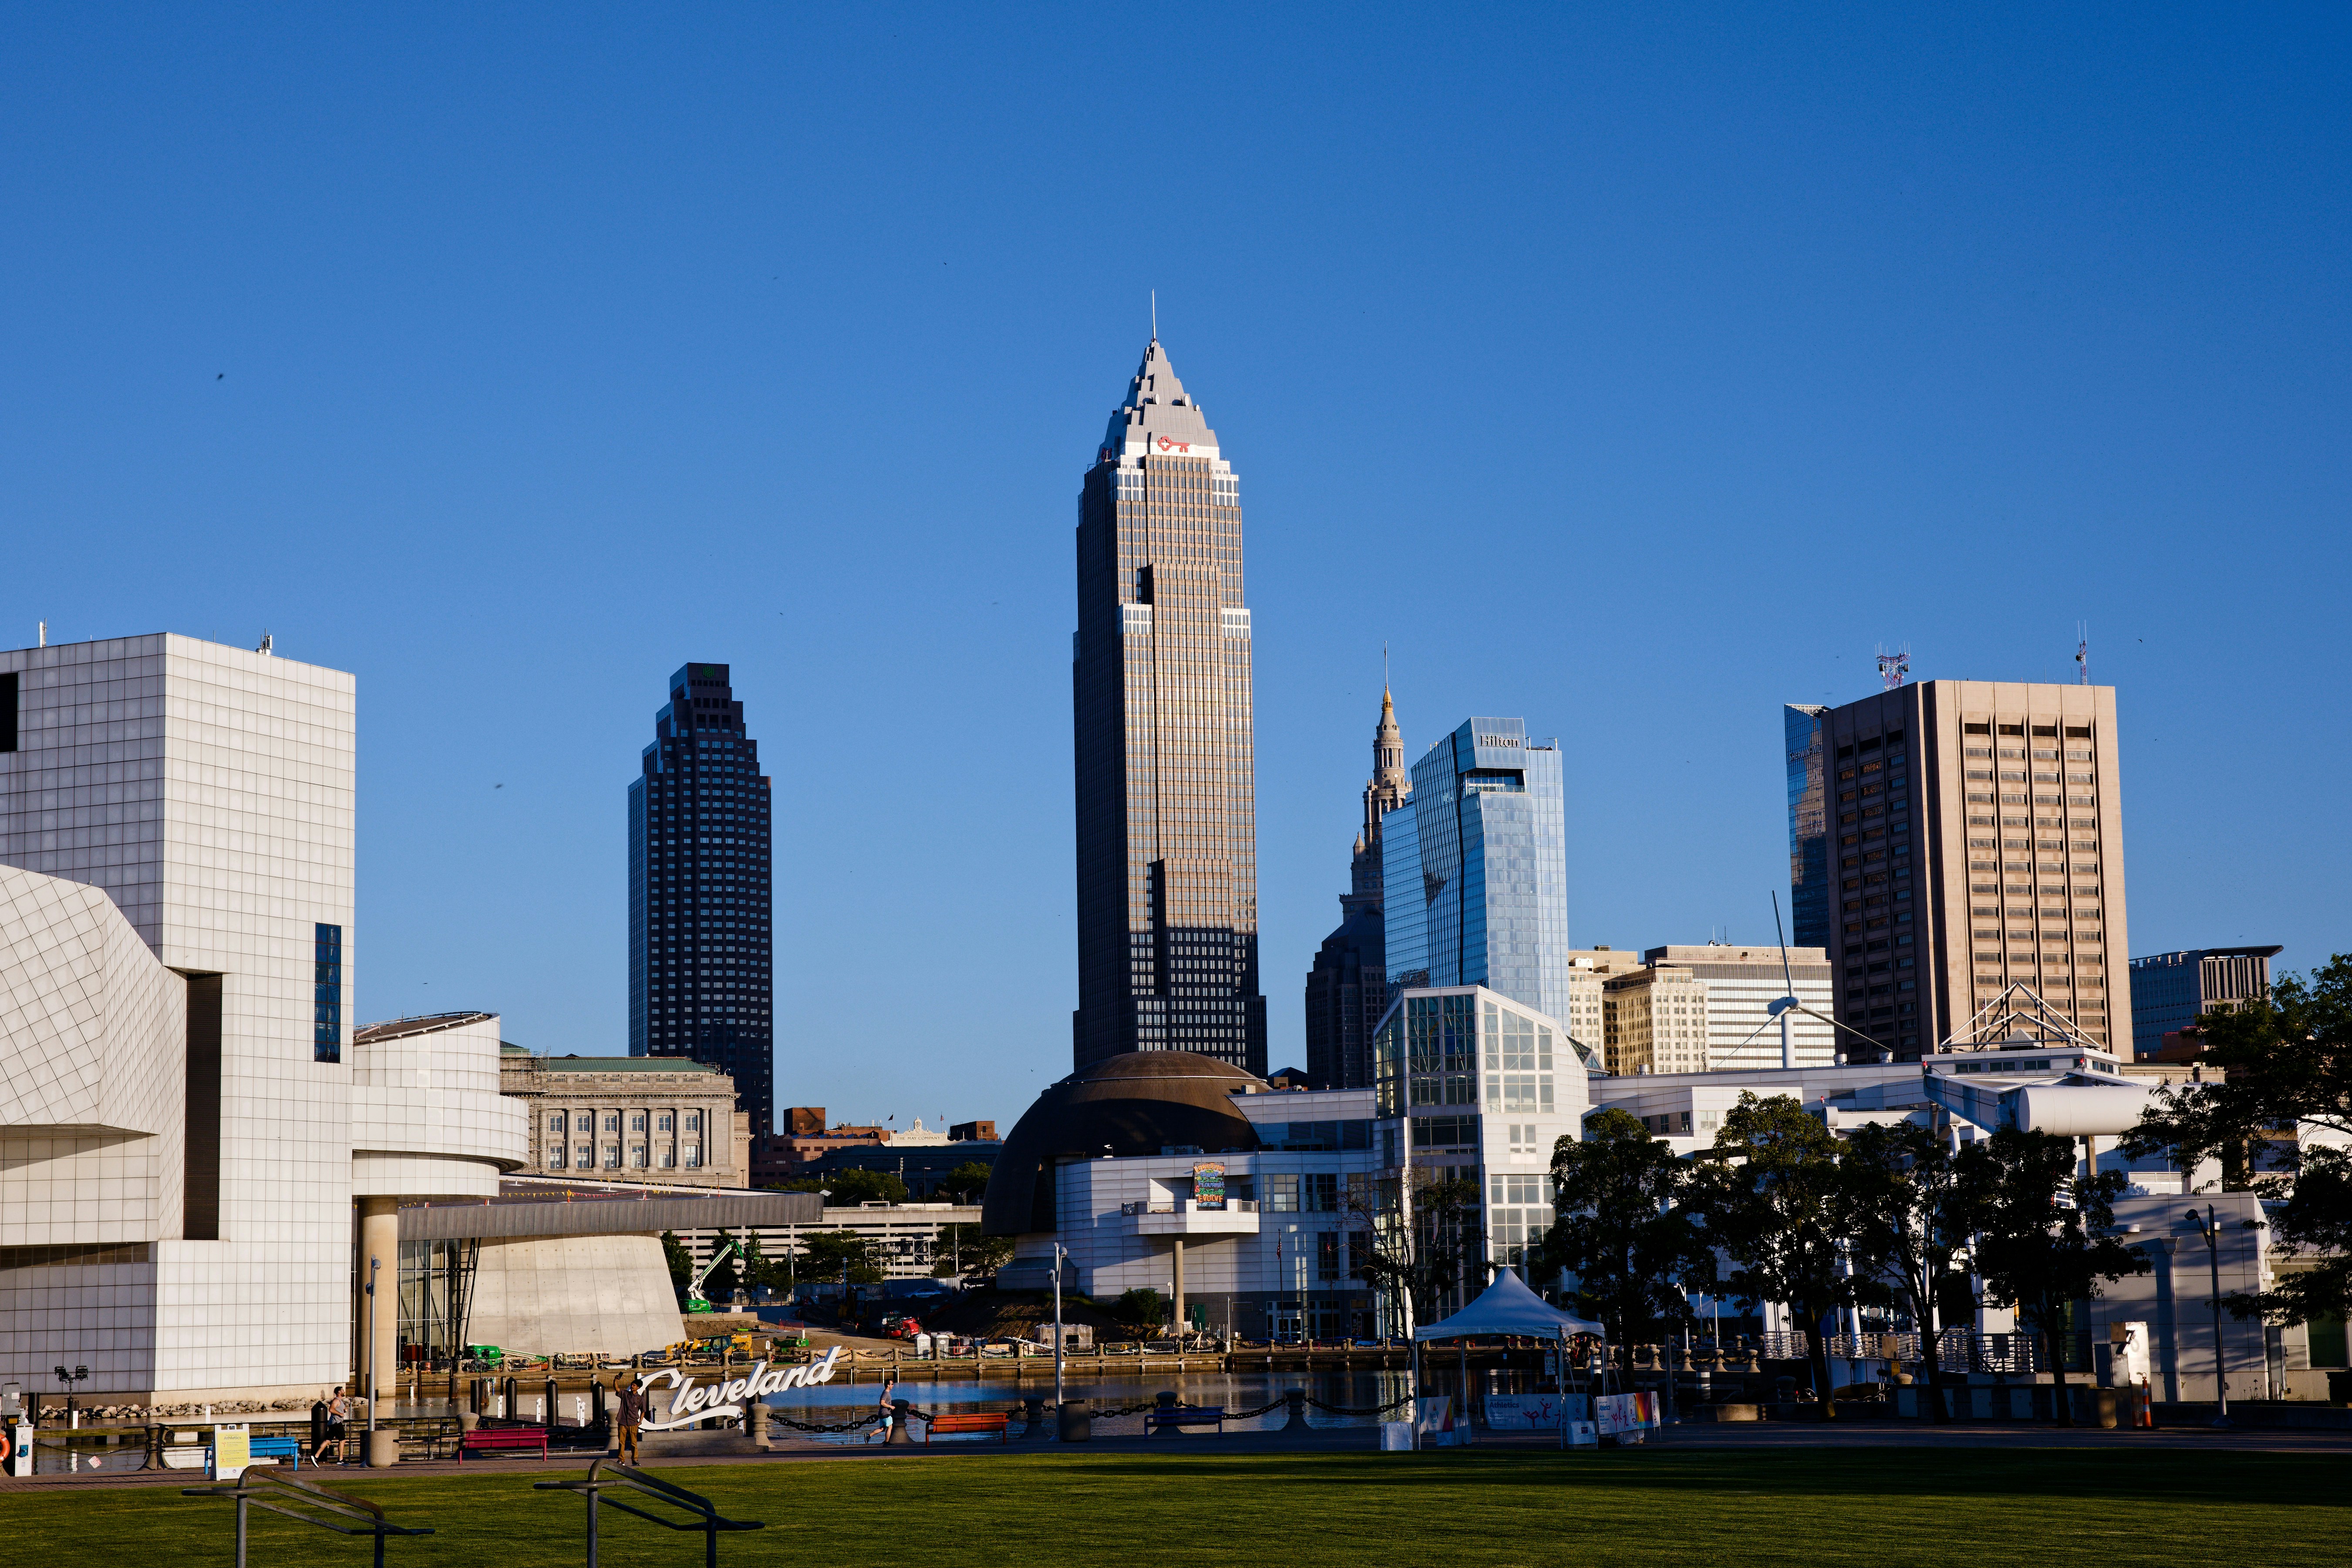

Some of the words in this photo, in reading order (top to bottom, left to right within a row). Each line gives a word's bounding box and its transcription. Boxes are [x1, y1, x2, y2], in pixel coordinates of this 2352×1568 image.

[1480, 735, 1520, 747] Hilton
[1193, 1163, 1211, 1173] LAKE
[1210, 1162, 1225, 1172] ERIE
[1196, 1187, 1226, 1196] Naturally
[1198, 1195, 1223, 1203] EVOLVE
[628, 1346, 842, 1430] Cleveland
